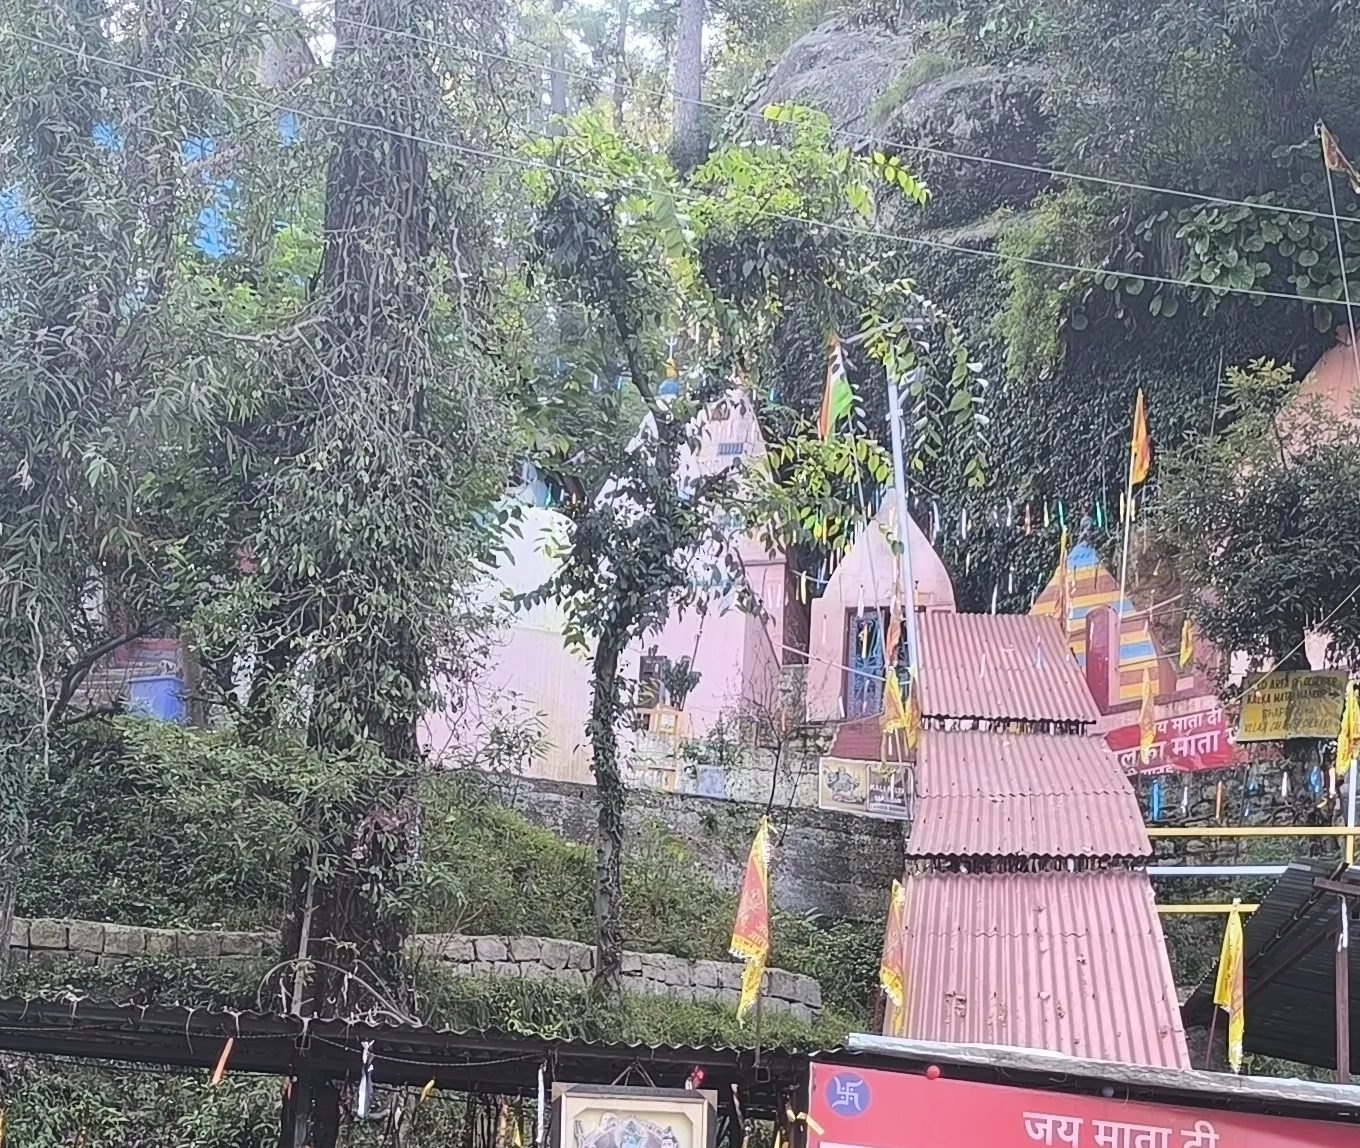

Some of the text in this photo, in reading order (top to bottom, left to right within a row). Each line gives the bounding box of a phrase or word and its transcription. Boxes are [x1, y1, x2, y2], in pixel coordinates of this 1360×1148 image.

[1172, 715, 1203, 732] माता
[1171, 729, 1220, 757] माता
[1022, 1112, 1083, 1148] जय
